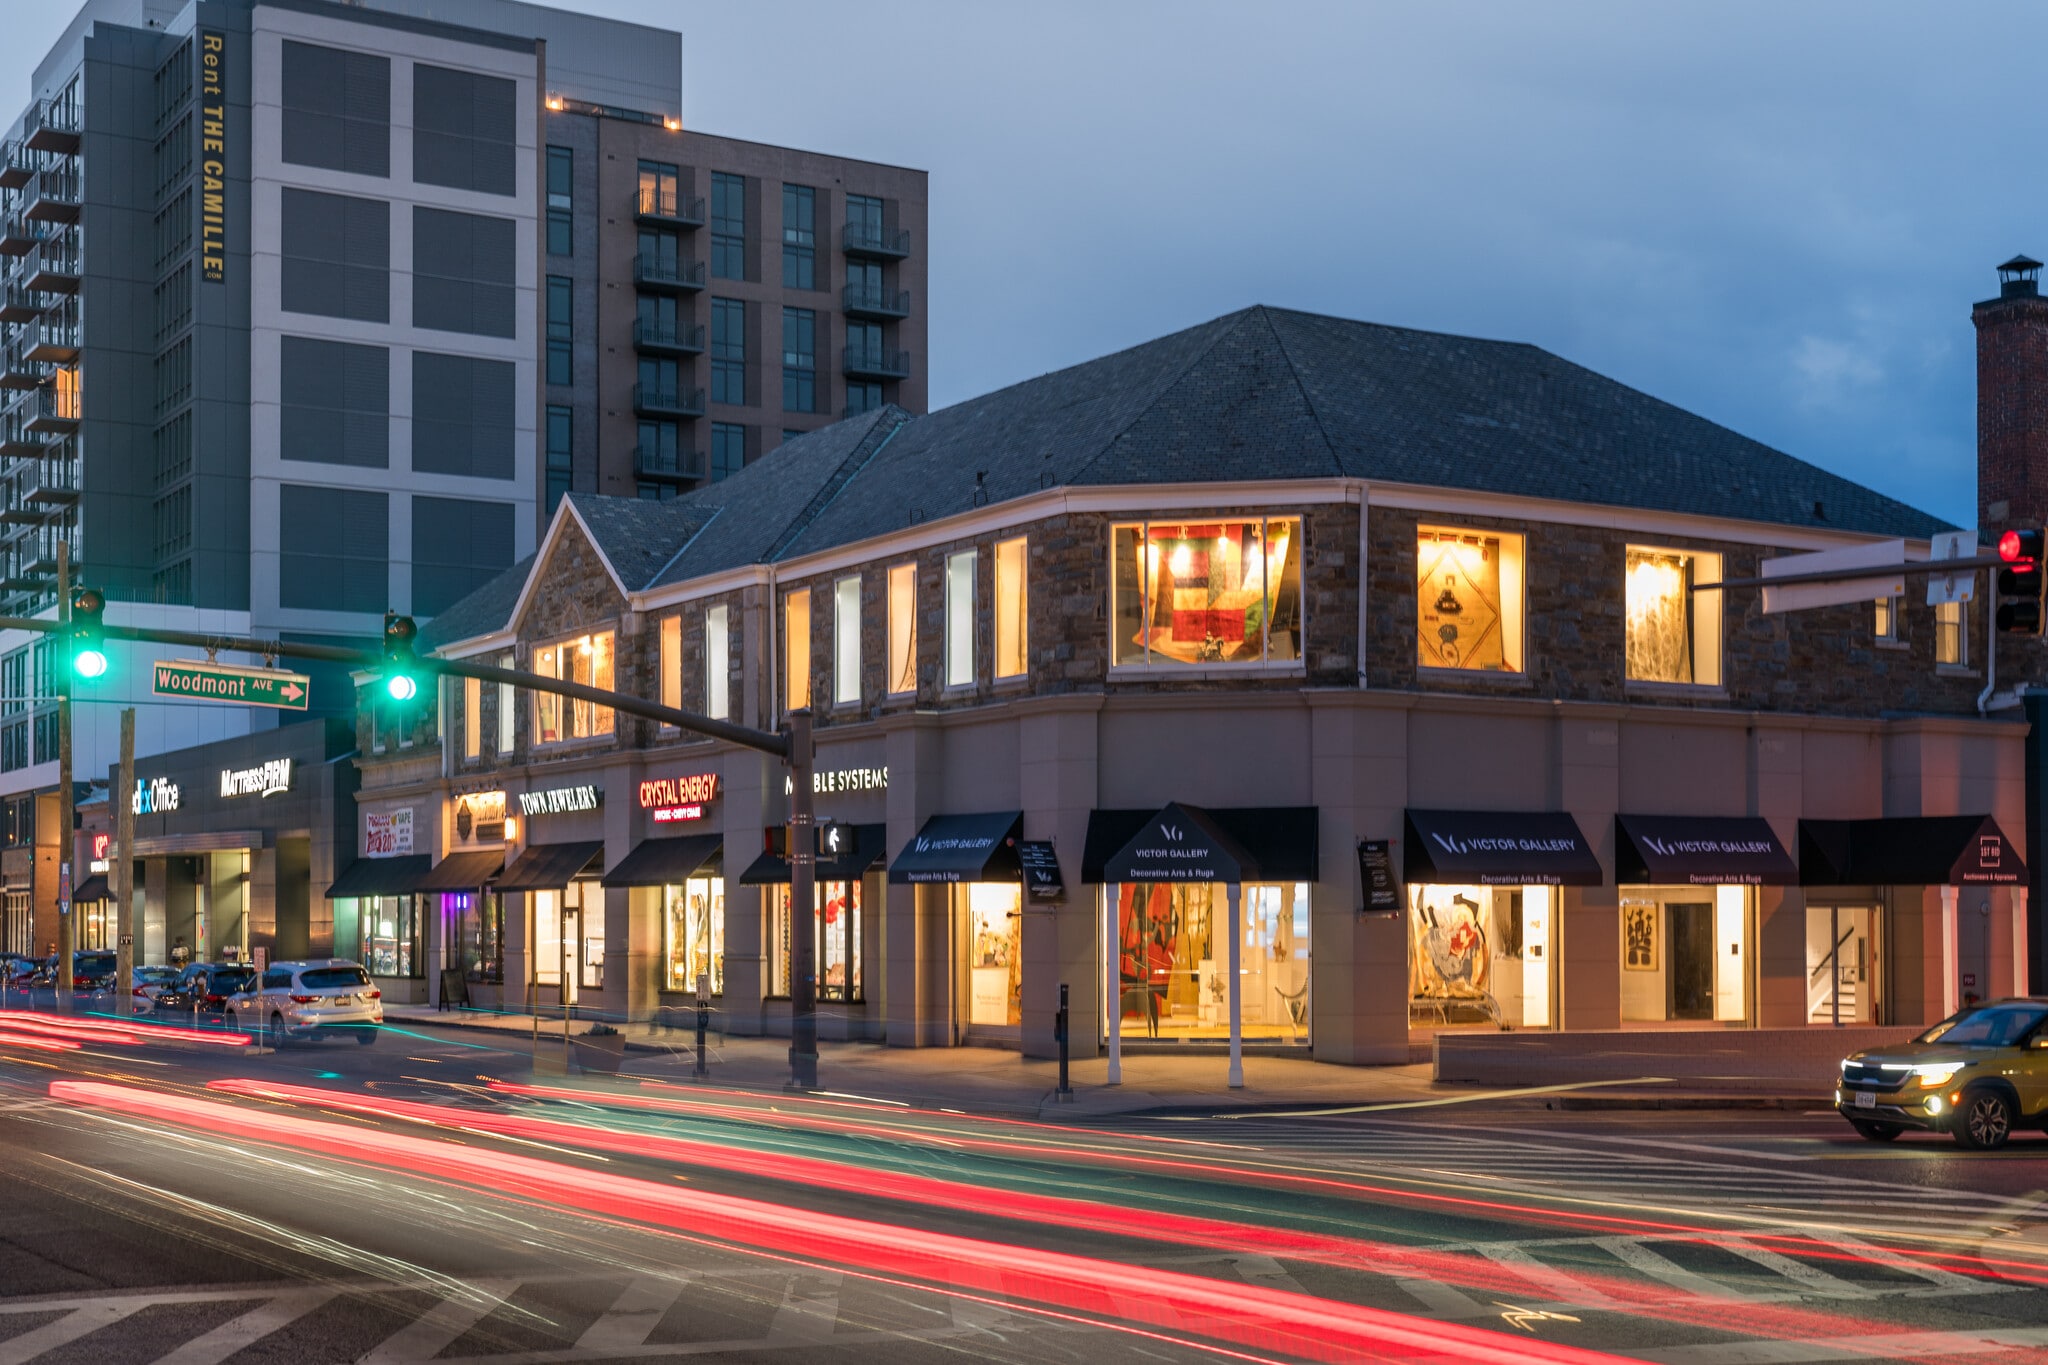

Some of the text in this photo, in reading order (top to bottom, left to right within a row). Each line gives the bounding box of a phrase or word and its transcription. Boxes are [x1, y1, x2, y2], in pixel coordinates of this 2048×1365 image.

[203, 35, 223, 270] Rent THE CAMILLE
[158, 668, 274, 696] Woodmont AVE
[640, 774, 716, 808] CRYSTAL ENERGY
[785, 772, 835, 796] MBLE
[151, 776, 178, 813] Office
[519, 791, 548, 816] TOWN
[546, 785, 597, 812] JEWELERS
[931, 838, 960, 850] VICTOR
[958, 836, 994, 849] GALLERY
[1467, 838, 1518, 850] VICTOR
[1519, 839, 1576, 852] GALLERY
[1674, 840, 1720, 852] VICTOR
[1721, 841, 1772, 854] GALLERY
[1136, 848, 1208, 858] VICTOR GALLERY
[908, 872, 960, 882] Decorative Arts & Rugs
[1130, 868, 1214, 878] Decorative Arts & Rugs
[1481, 874, 1560, 885] Decorative Arts & Rugs
[1690, 874, 1762, 884] Decorative Arts & Rugs
